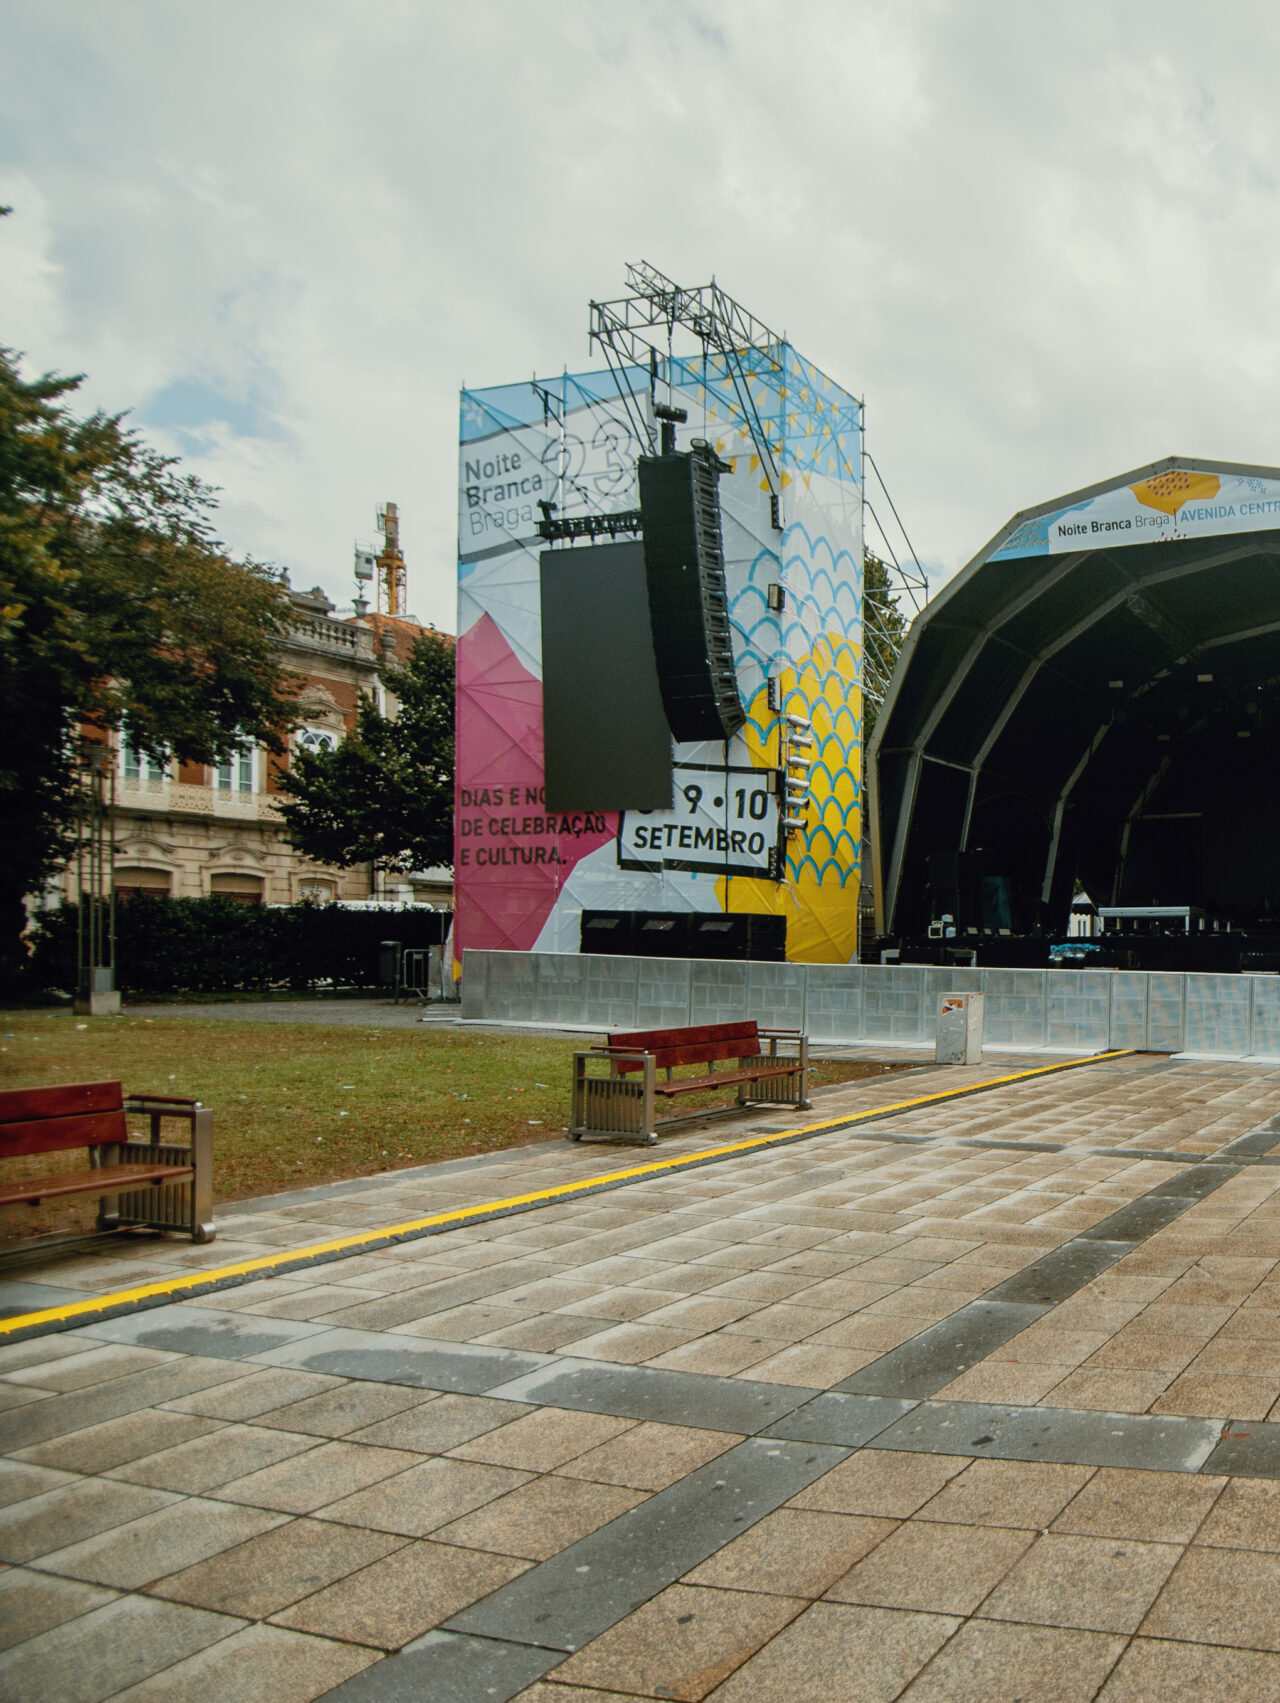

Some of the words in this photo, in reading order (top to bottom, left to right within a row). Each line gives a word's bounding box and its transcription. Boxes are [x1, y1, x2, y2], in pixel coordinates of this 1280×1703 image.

[464, 452, 522, 482] Noite
[466, 473, 543, 508] Branca
[469, 503, 533, 536] Braga
[1058, 524, 1088, 537] Noite
[1091, 518, 1132, 533] Branca
[1135, 514, 1170, 528] Braga
[1180, 505, 1236, 522] AVENIDA
[461, 789, 504, 807] DIAS
[510, 788, 520, 806] E
[683, 784, 703, 814] 9
[735, 788, 768, 820] 10
[461, 818, 483, 836] DE
[488, 811, 606, 838] CELEBRAÇÃO
[633, 823, 765, 855] SETEMBRO
[461, 848, 470, 866] E
[476, 846, 567, 866] CULTURA.
